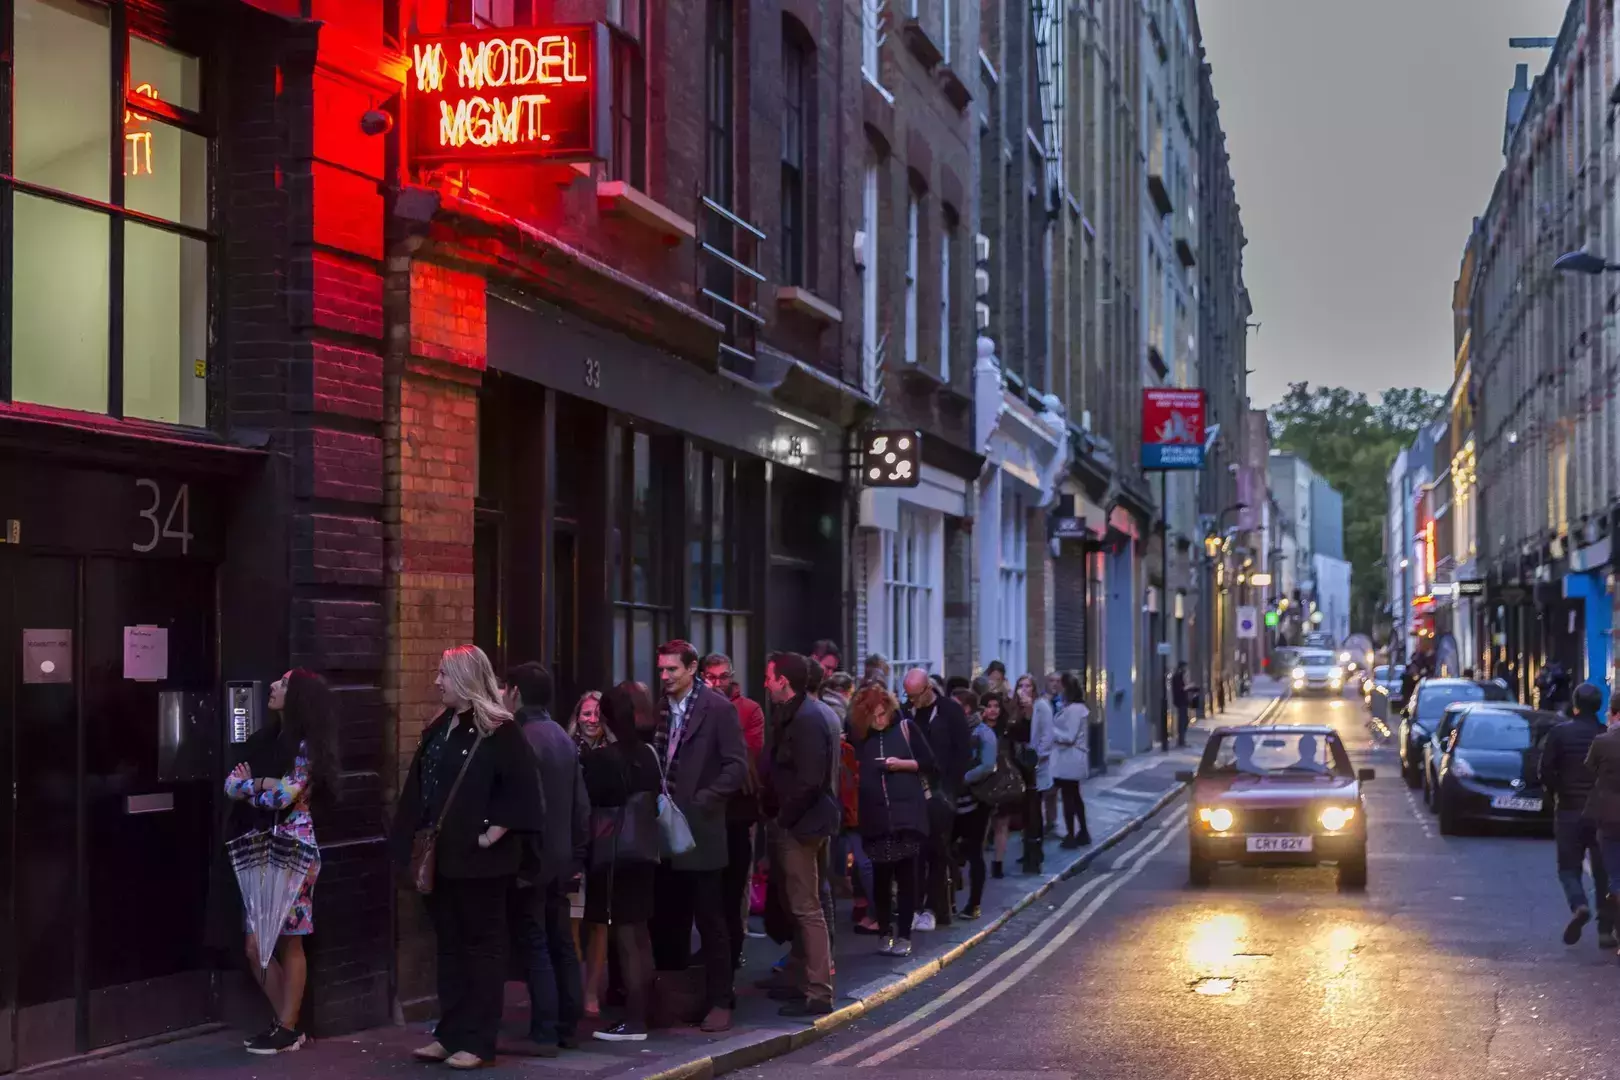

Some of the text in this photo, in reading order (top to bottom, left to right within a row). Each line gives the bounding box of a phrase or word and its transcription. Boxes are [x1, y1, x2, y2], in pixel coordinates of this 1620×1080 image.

[413, 35, 587, 92] W MODEL
[439, 94, 549, 147] MGMT.
[585, 357, 601, 389] 33
[132, 477, 195, 556] 34
[1255, 838, 1304, 850] CRY 82Y
